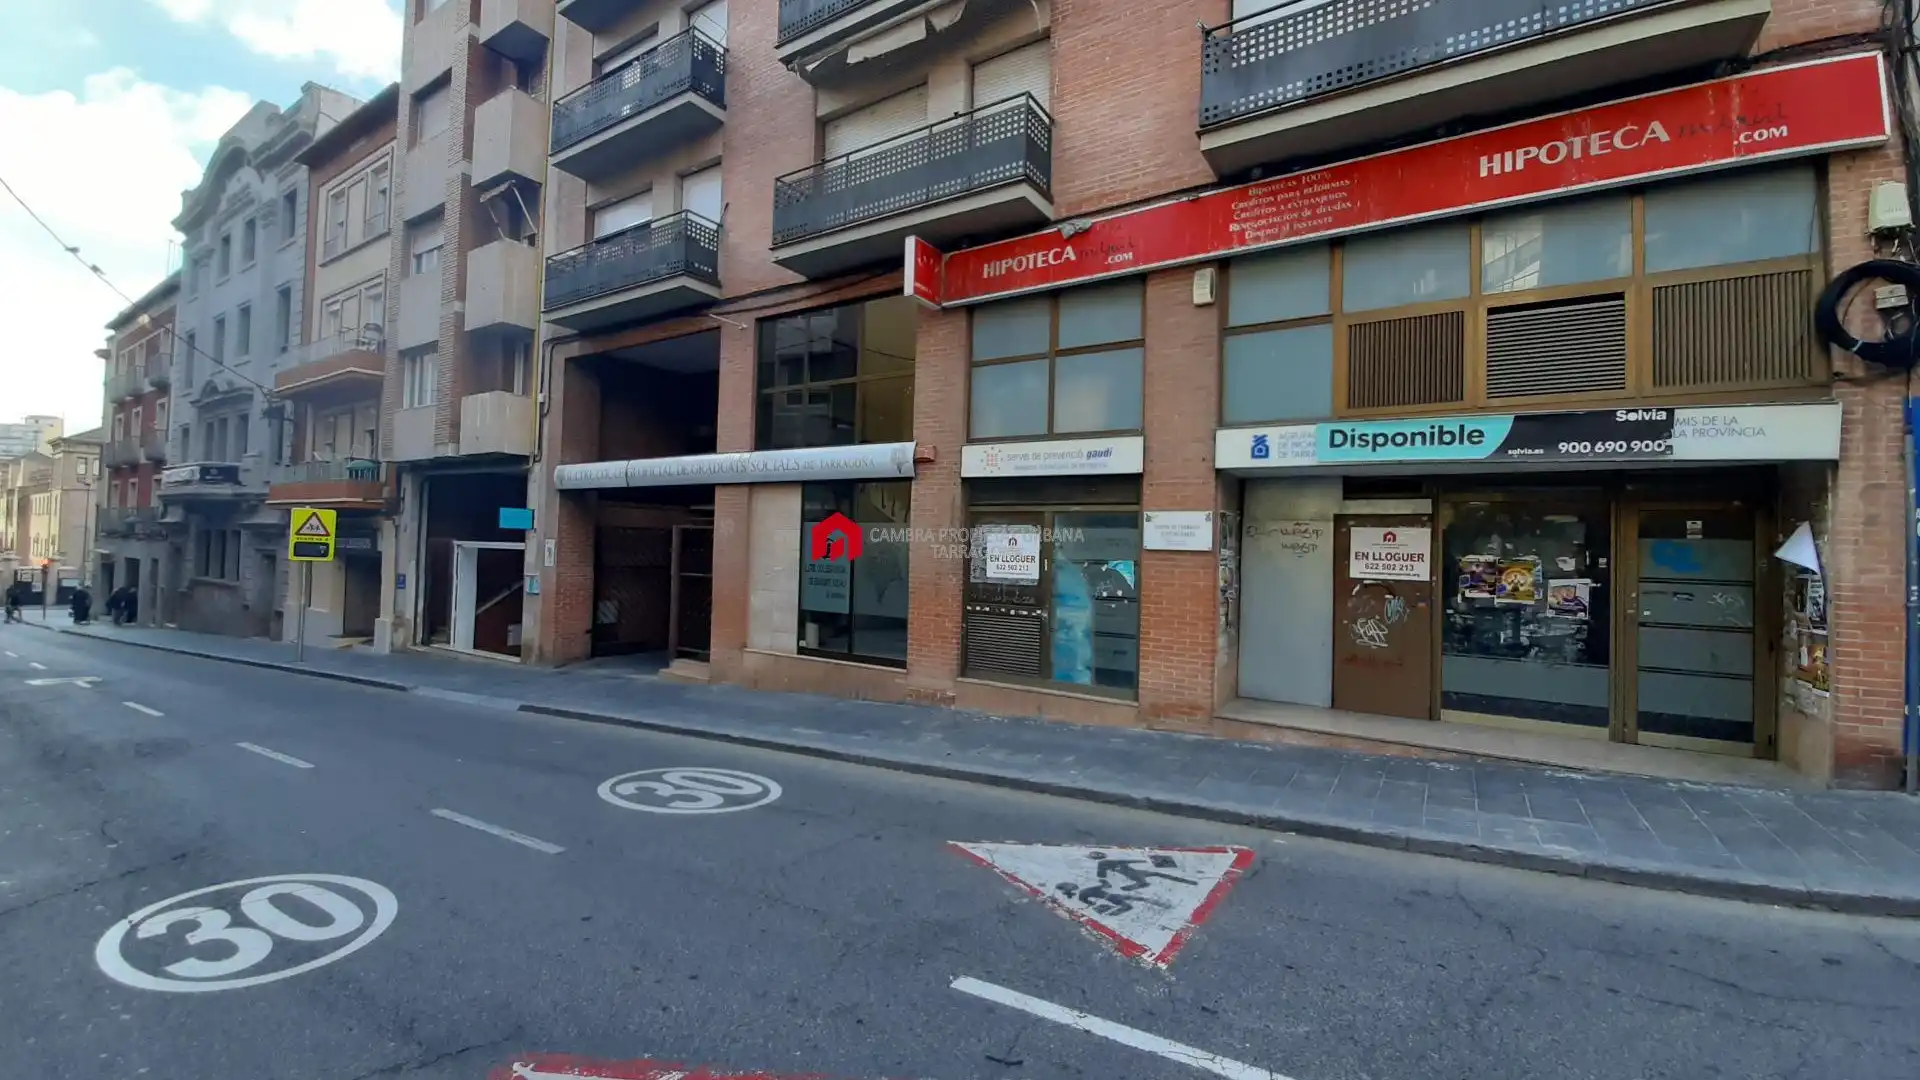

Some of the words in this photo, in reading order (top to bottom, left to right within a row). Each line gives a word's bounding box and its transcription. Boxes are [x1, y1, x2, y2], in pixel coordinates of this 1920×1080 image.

[1733, 125, 1788, 144] .COM
[1479, 120, 1670, 177] HIPOTECA
[983, 245, 1076, 278] HIPOTECA
[1615, 408, 1667, 422] Solvia
[1329, 423, 1486, 452] Disponible
[1692, 427, 1766, 438] PROVINCIA
[1558, 442, 1591, 454] 900
[1594, 440, 1627, 453] 690
[1630, 439, 1665, 452] 900
[989, 554, 1000, 563] EN
[1001, 553, 1036, 564] LLOGUER
[1354, 551, 1369, 561] EN
[1372, 552, 1425, 563] LLOGUER
[1364, 562, 1379, 570] 622
[614, 769, 764, 808] 30
[137, 882, 364, 978] 30
